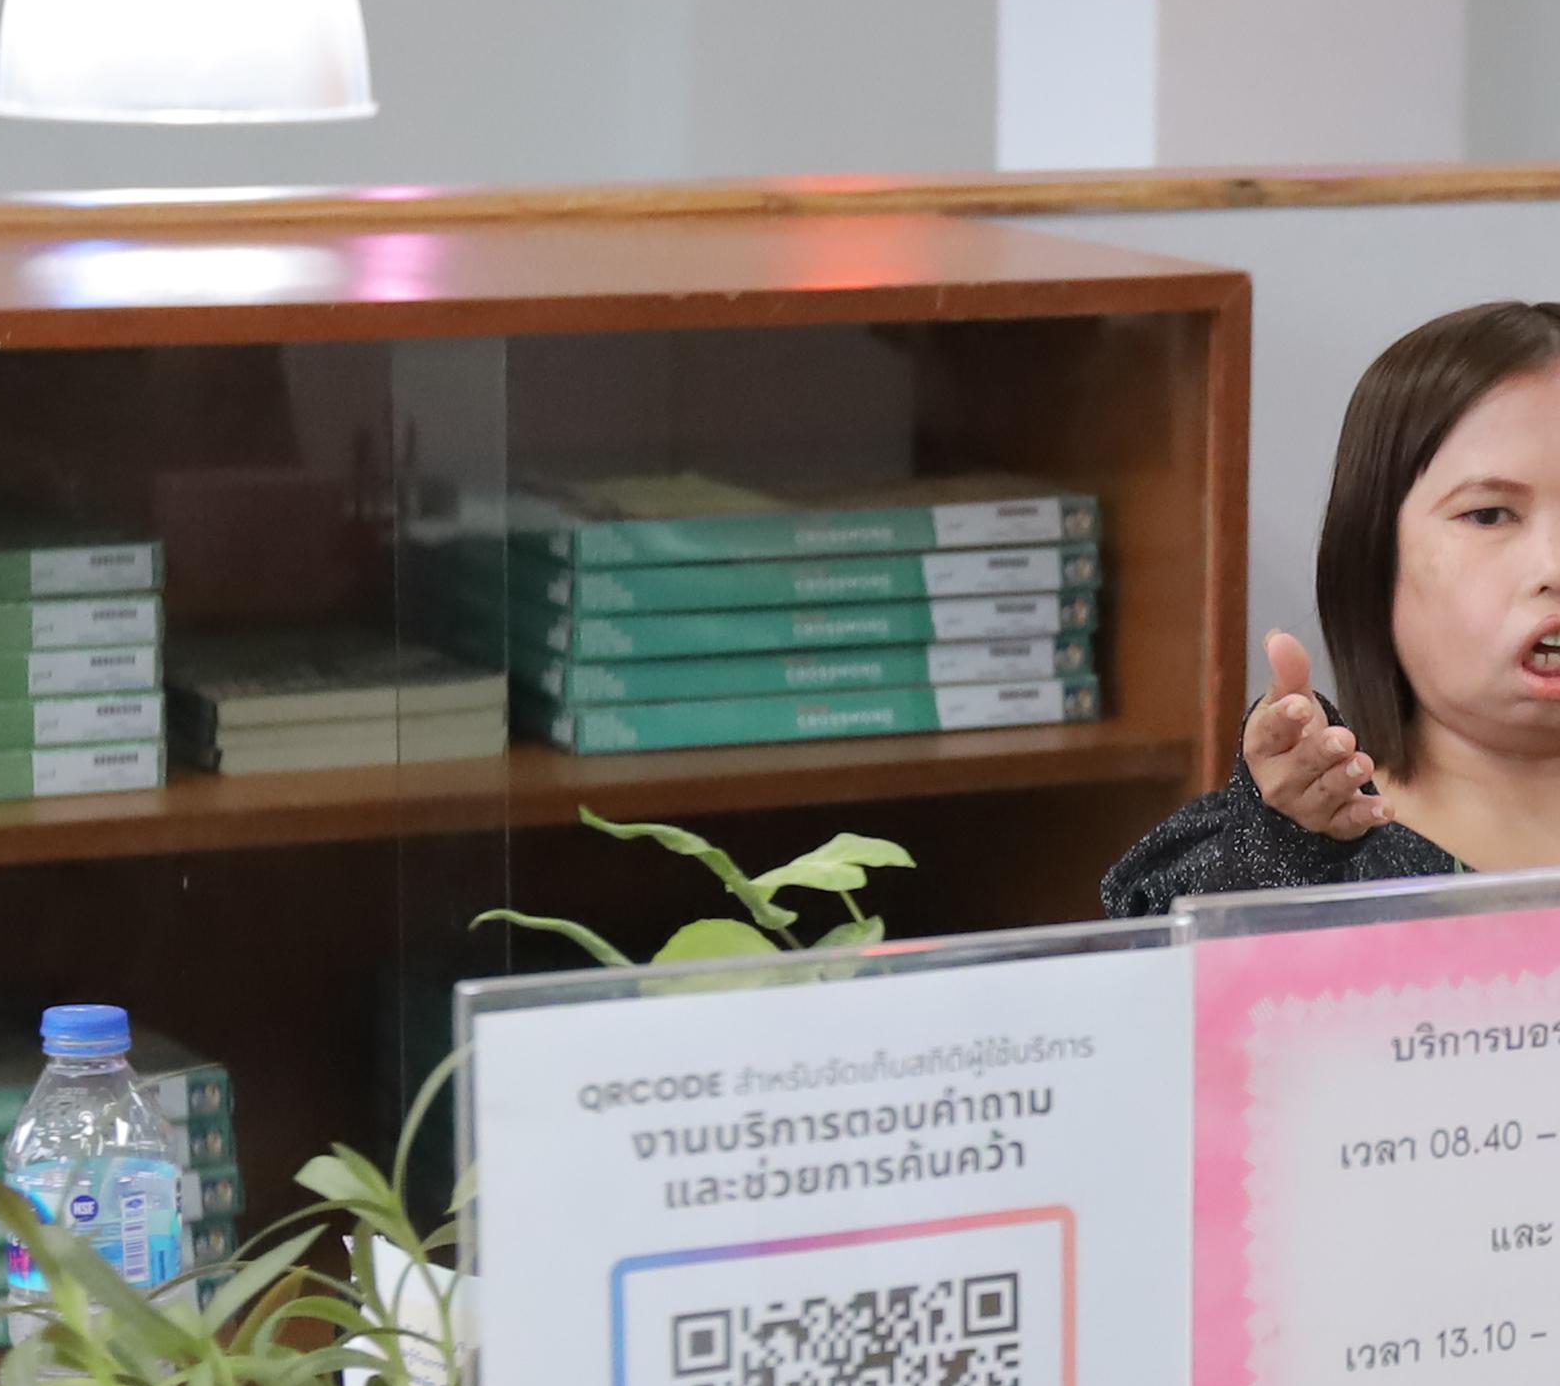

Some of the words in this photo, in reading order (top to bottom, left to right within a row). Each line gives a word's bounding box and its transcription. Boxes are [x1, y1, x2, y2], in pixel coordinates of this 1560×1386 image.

[578, 1069, 725, 1114] QRCODE
[631, 1081, 1055, 1160] งานบริการตอบคำถาม
[664, 1128, 1026, 1210] และช่วยการค้นคว้า
[1341, 1135, 1417, 1169] เวลา
[1430, 1121, 1522, 1159] 08.40
[1491, 1221, 1553, 1252] และ
[1346, 1336, 1421, 1371] เวลา
[1437, 1322, 1517, 1361] 13.10
